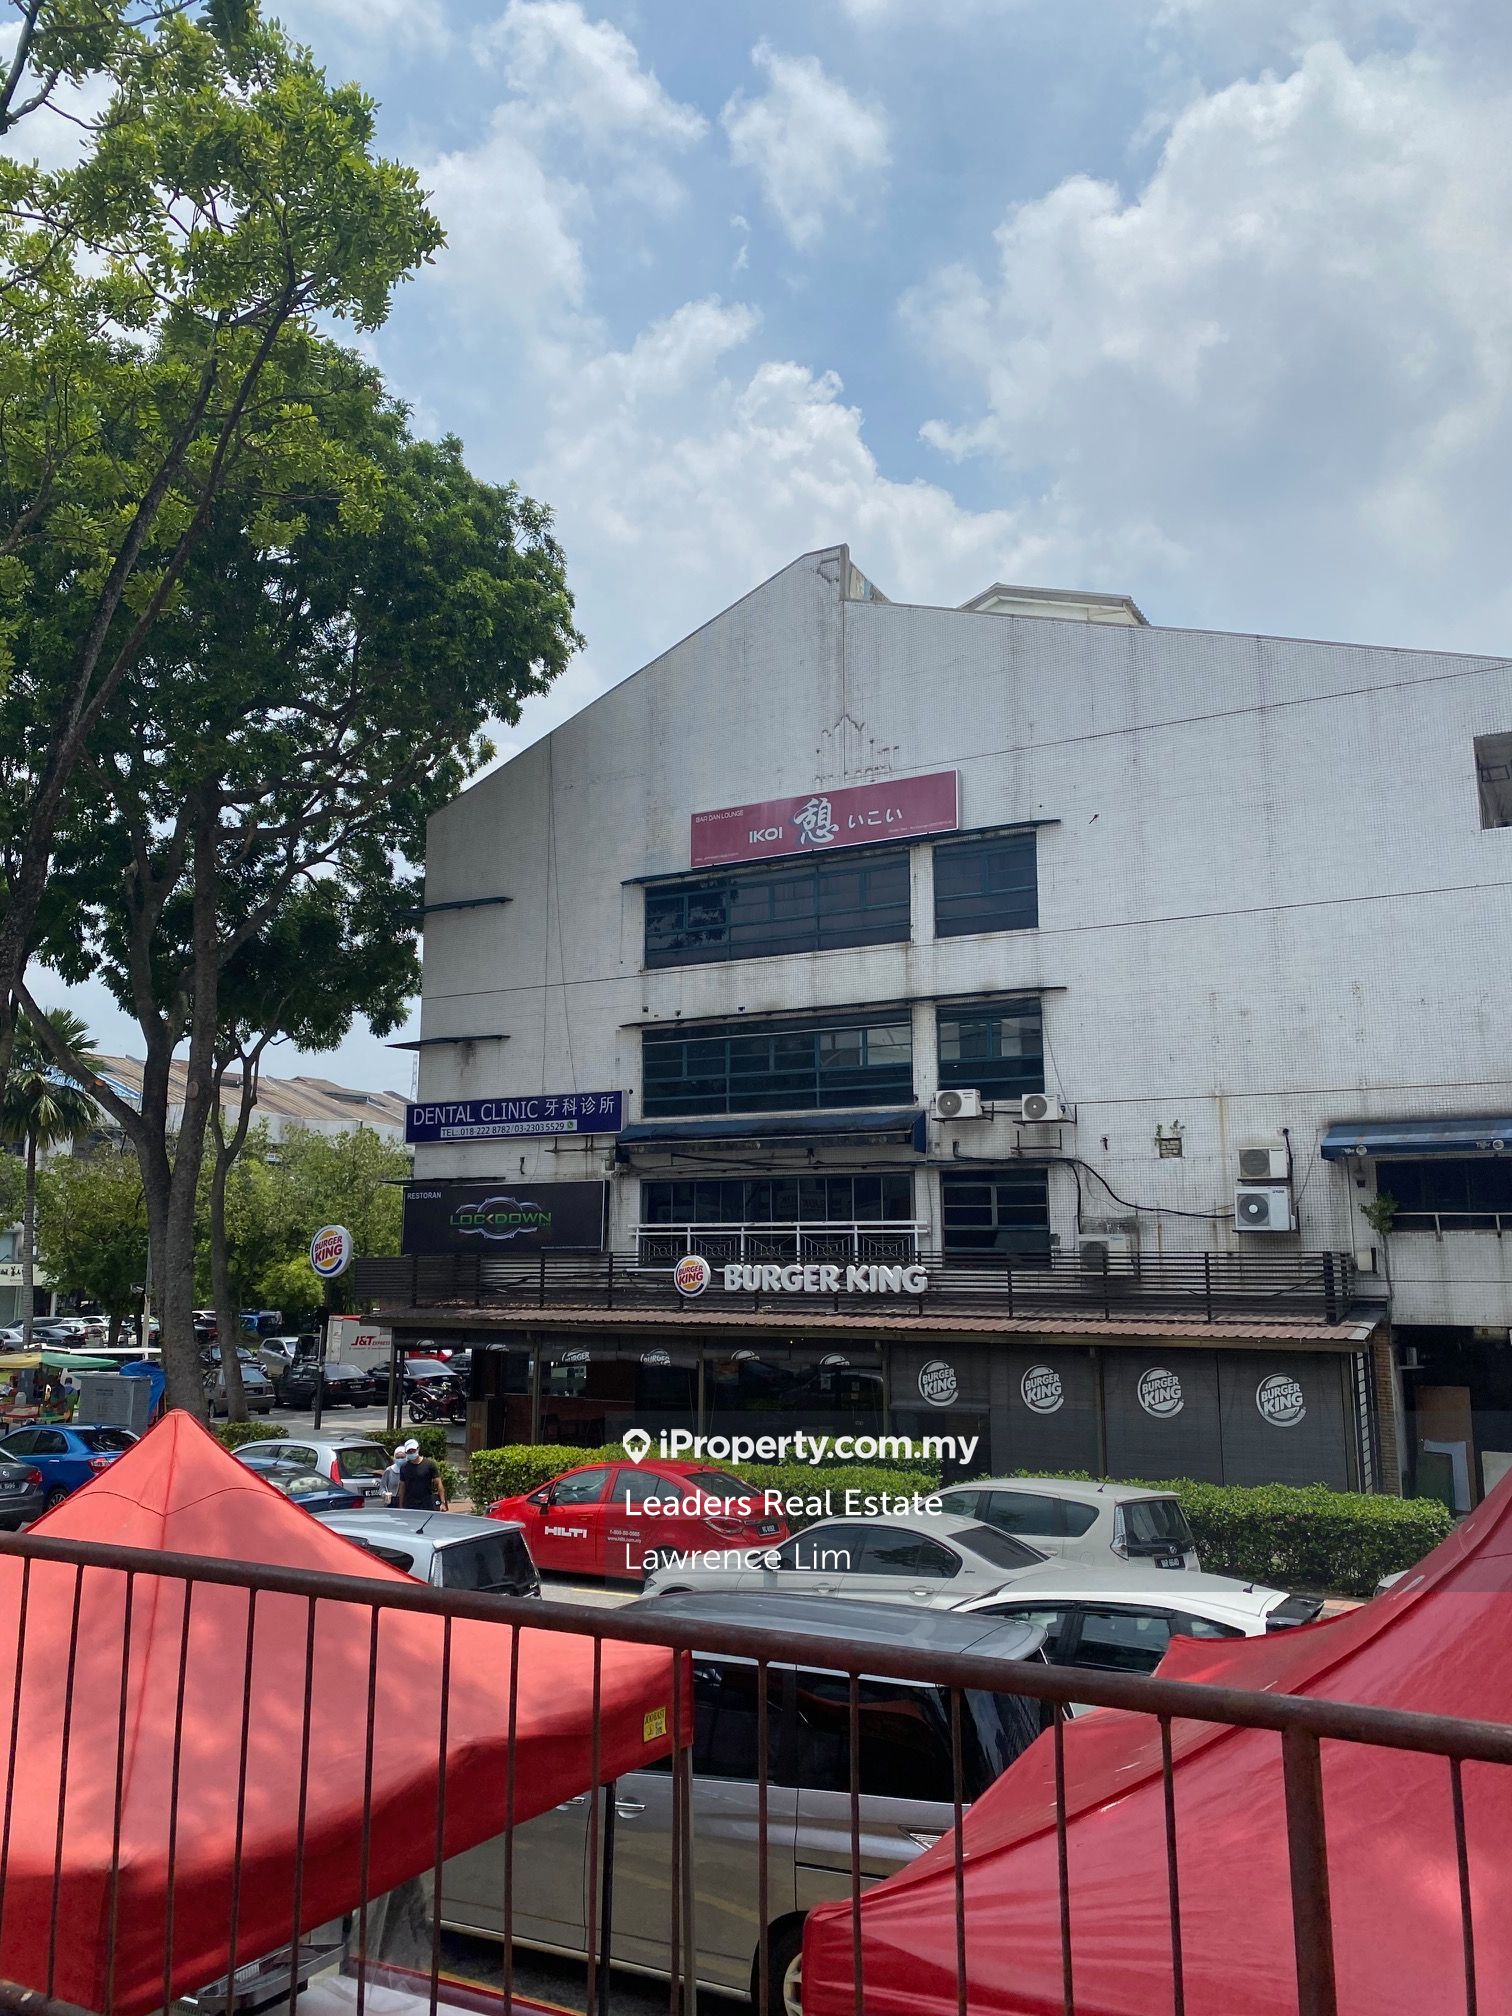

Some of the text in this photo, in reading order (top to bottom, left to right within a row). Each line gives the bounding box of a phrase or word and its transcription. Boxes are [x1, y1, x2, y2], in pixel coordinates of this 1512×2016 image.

[708, 814, 720, 822] DAN
[721, 810, 744, 820] LOUNGE
[749, 827, 783, 843] IKOI
[794, 797, 839, 845] 憩
[848, 808, 903, 829] いこい
[413, 1096, 615, 1126] DENTAL CLINIC 牙科诊所
[407, 1192, 442, 1200] RESTORAN
[450, 1212, 551, 1225] LOCKDOWN
[314, 1235, 343, 1252] BURGER
[314, 1244, 343, 1264] KING
[678, 1265, 703, 1276] BURGER
[679, 1271, 704, 1286] KING
[725, 1264, 928, 1293] BURGER KING
[351, 1336, 376, 1346] J&T
[922, 1368, 955, 1385] BURGER
[1025, 1373, 1060, 1391] BURGER
[1142, 1376, 1179, 1394] BURGER
[924, 1376, 957, 1398] KING
[1026, 1382, 1062, 1403] KING
[1144, 1385, 1181, 1407] KING
[1261, 1383, 1301, 1403] BURGER
[1263, 1393, 1303, 1416] KING
[545, 1526, 588, 1538] HILTI
